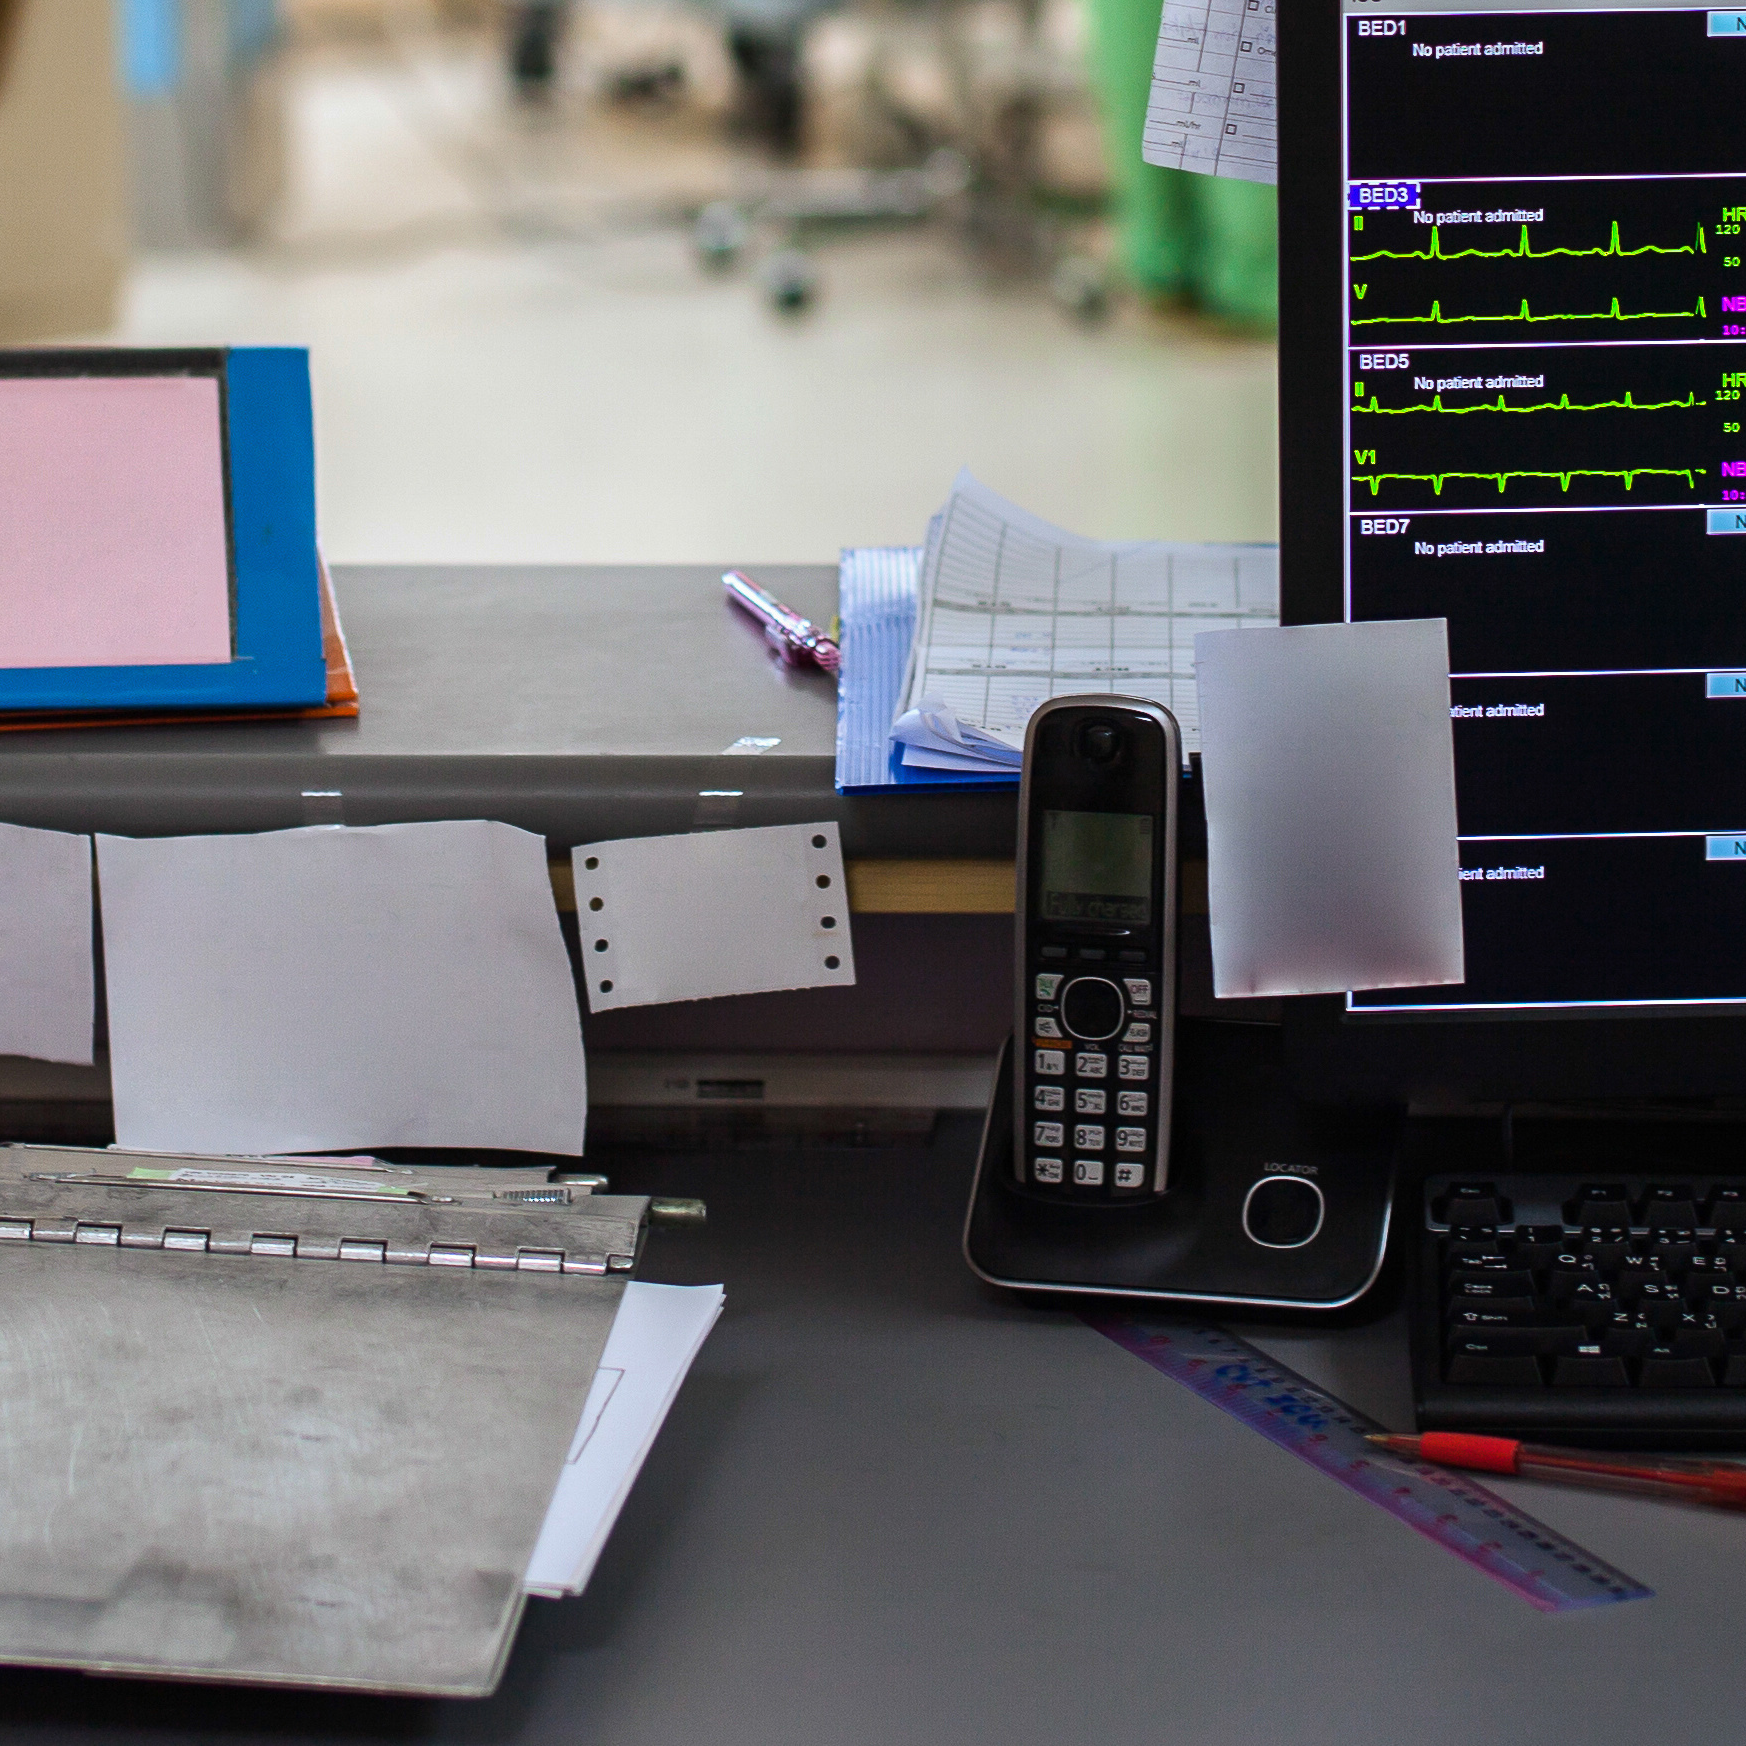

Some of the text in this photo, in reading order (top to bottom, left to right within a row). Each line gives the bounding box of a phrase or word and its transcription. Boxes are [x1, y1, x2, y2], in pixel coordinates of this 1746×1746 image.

[1358, 20, 1405, 36] BED1
[1413, 42, 1543, 59] No patient admitted
[1360, 185, 1408, 203] BED3
[1413, 209, 1543, 226] No patient admitted
[1716, 225, 1740, 234] 120
[1723, 257, 1740, 267] 50
[1354, 284, 1367, 299] V
[1360, 354, 1412, 371] BED5
[1415, 375, 1544, 391] No patient admitted
[1715, 390, 1740, 400] 120
[1724, 423, 1740, 432] 50
[1354, 450, 1375, 465] V1
[1361, 519, 1410, 534] BED7
[1415, 540, 1544, 557] No patient admitted
[1486, 703, 1545, 717] admitted
[1486, 865, 1545, 880] admitted
[1078, 1057, 1087, 1073] 2
[1120, 1059, 1130, 1075] 3
[1078, 1093, 1087, 1108] 5
[1120, 1094, 1130, 1111] 6
[1077, 1130, 1087, 1146] 8
[1264, 1162, 1318, 1175] LOCATOR
